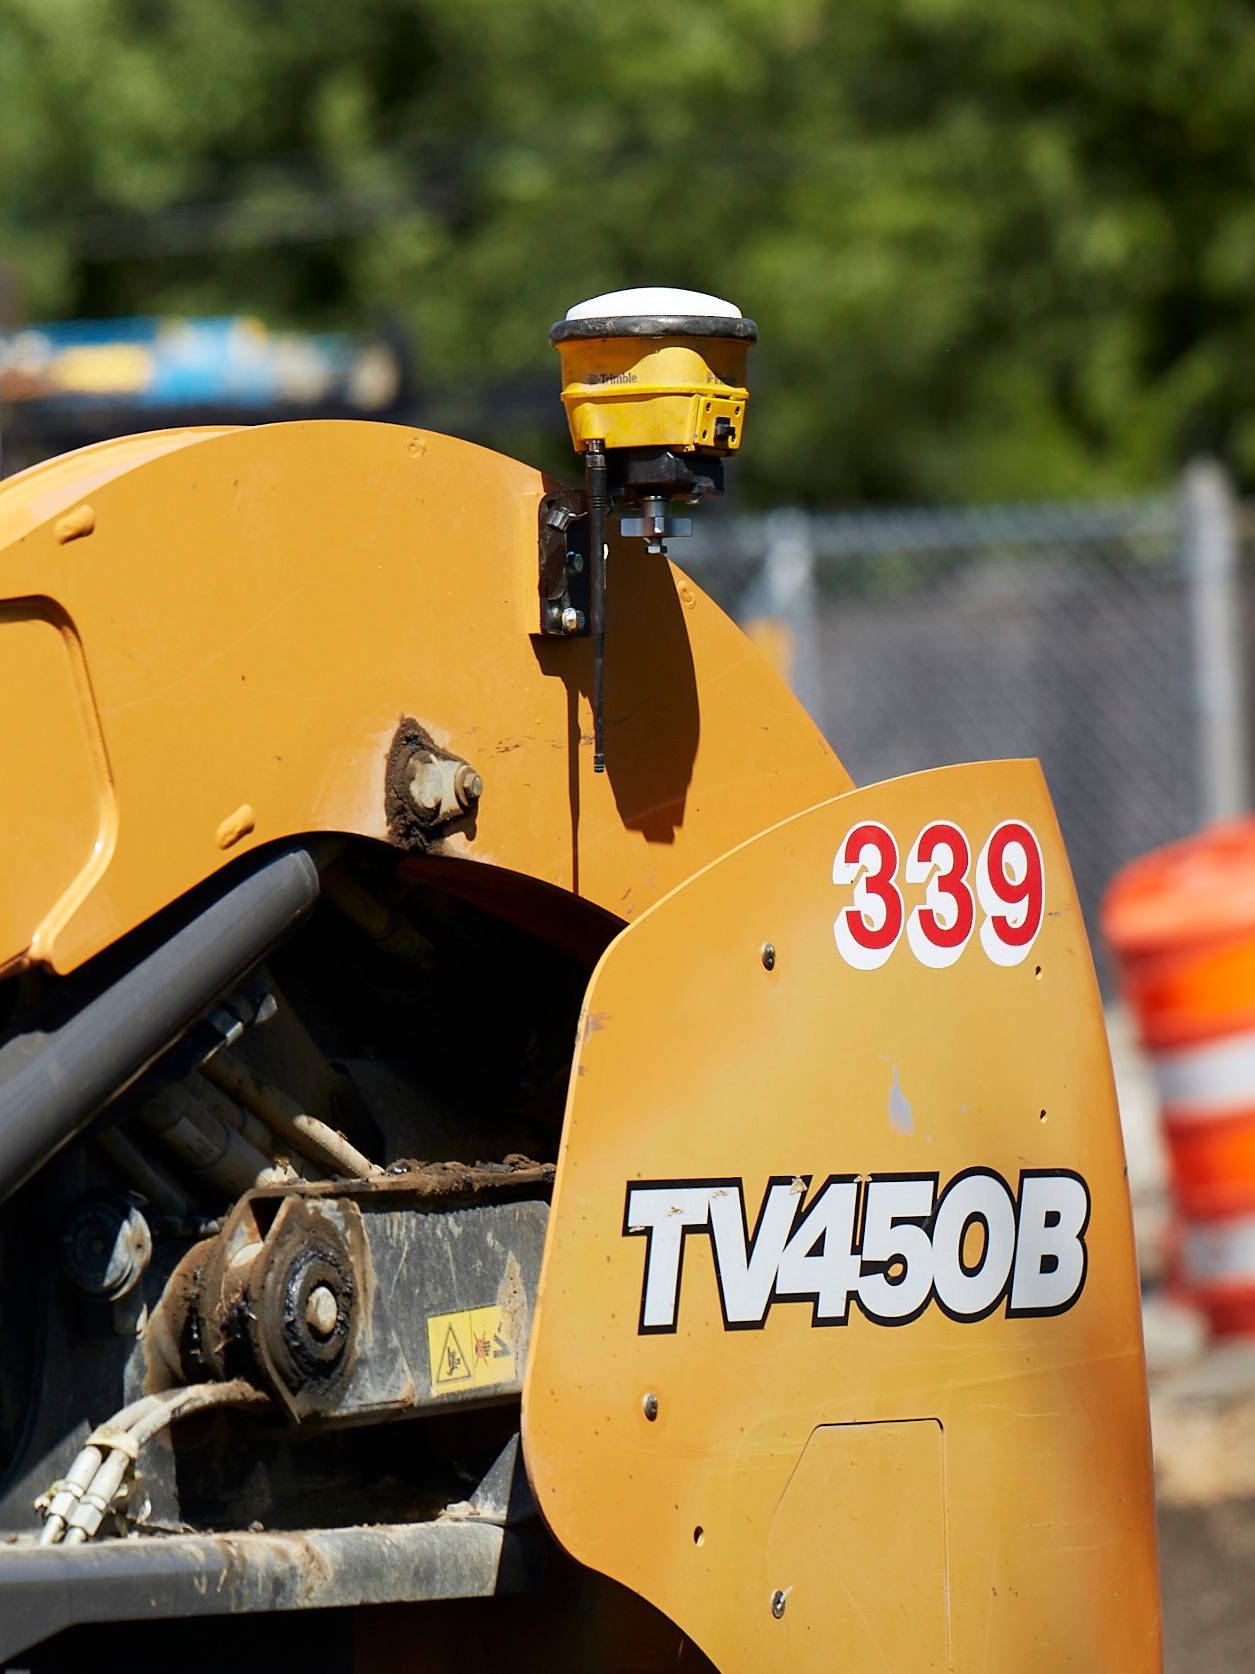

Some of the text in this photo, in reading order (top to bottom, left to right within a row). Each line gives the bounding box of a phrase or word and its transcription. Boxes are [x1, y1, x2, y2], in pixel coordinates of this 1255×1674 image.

[600, 372, 637, 384] Trimble
[833, 820, 1045, 970] 339
[622, 1166, 1091, 1336] TV450B
